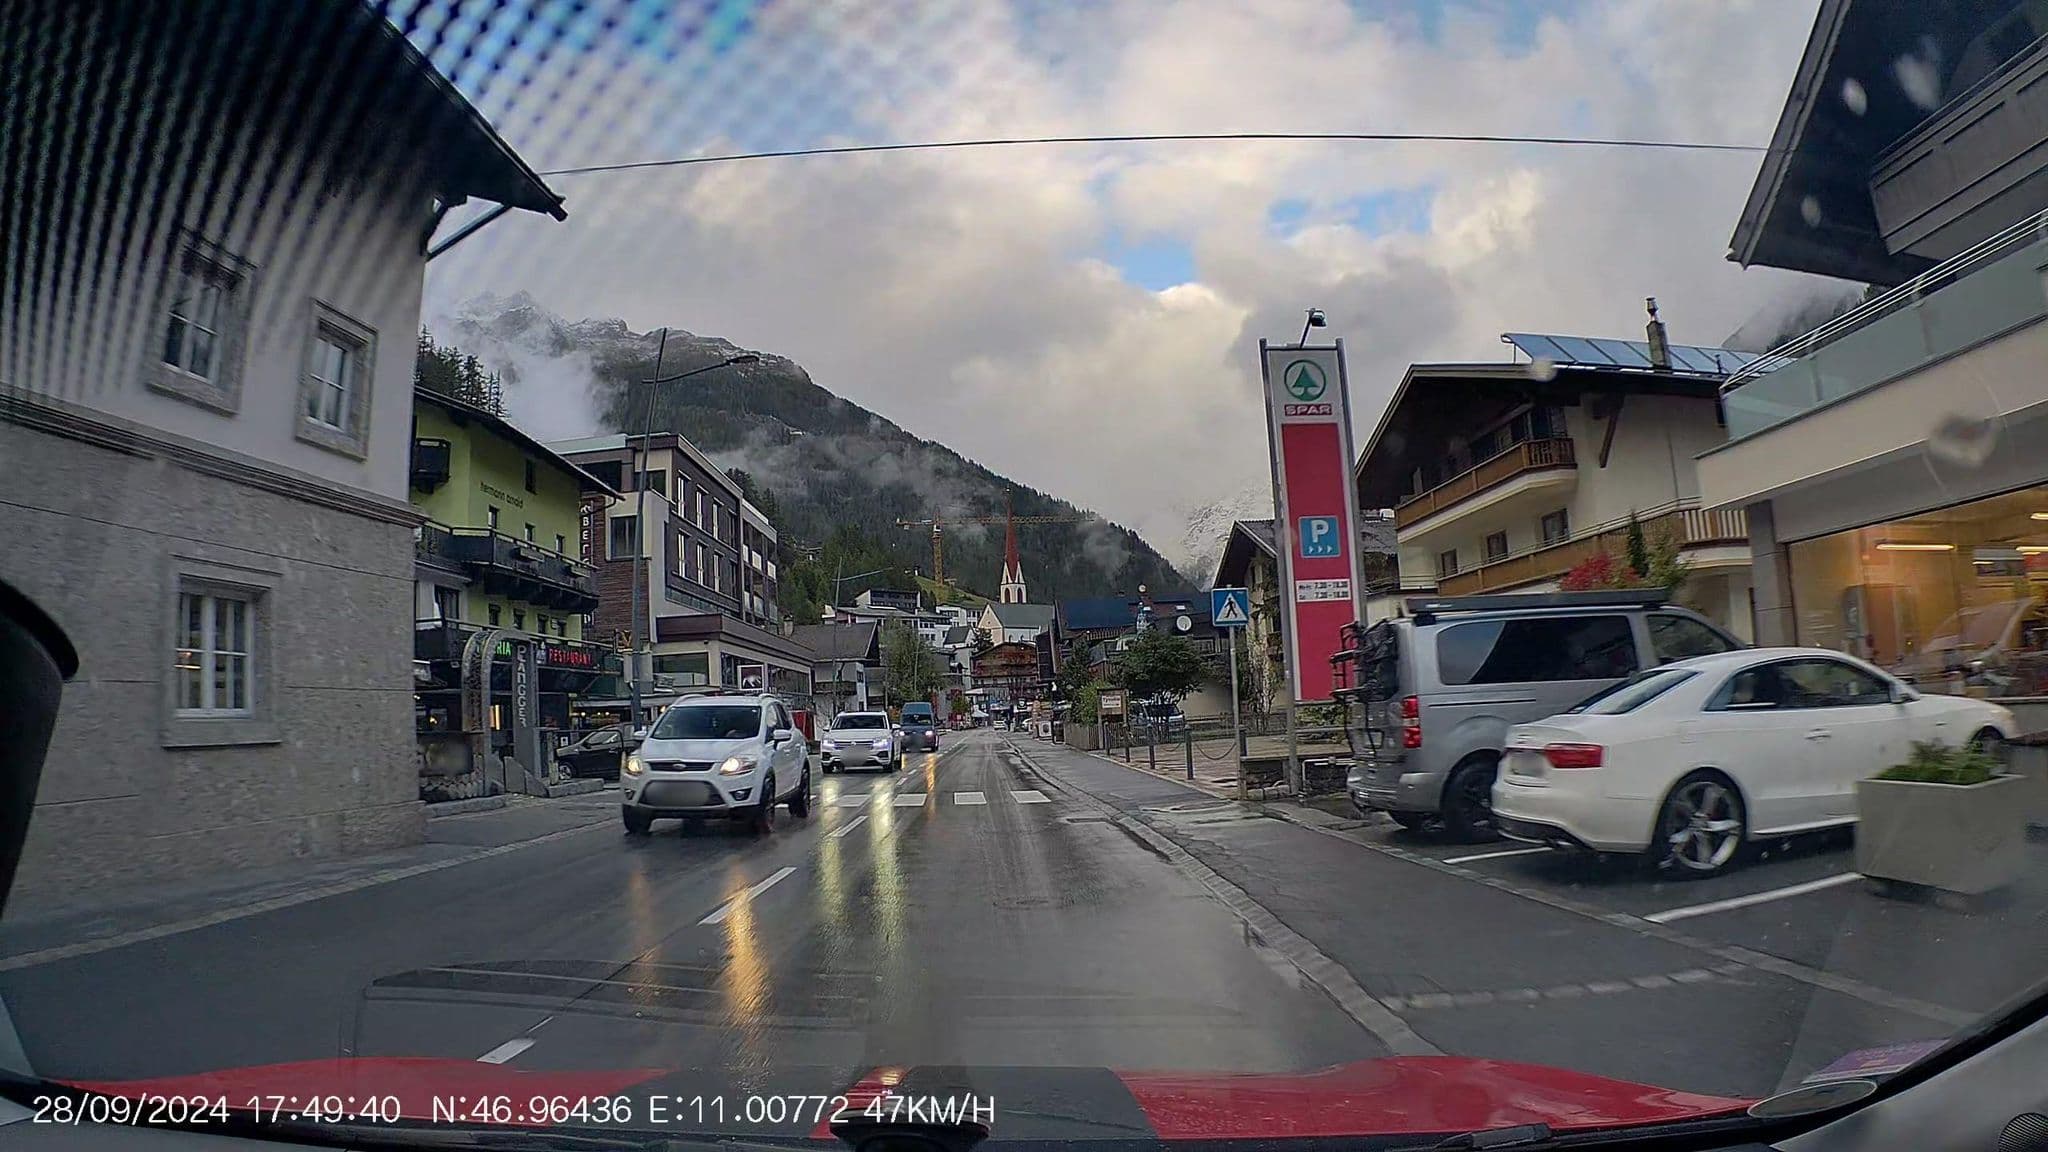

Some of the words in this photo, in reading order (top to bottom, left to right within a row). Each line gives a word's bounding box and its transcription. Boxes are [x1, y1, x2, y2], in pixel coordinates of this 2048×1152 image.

[1286, 405, 1331, 415] SPAR
[1311, 519, 1329, 543] P
[549, 648, 593, 665] RESTAURANT
